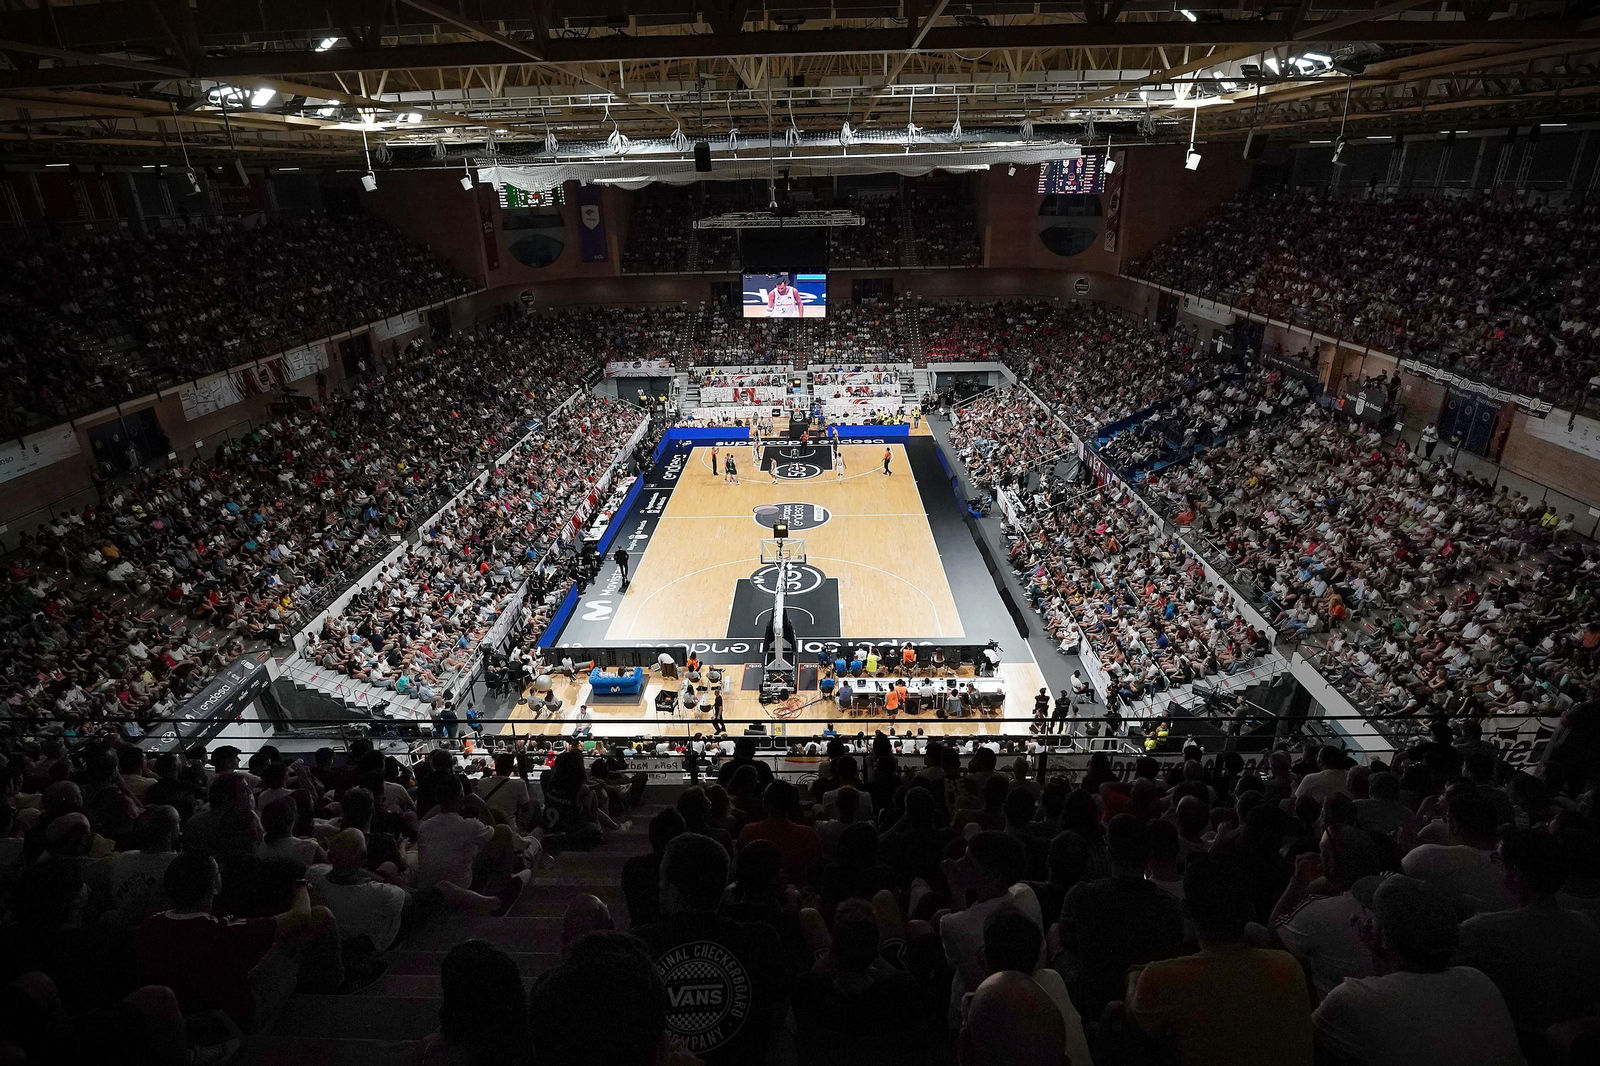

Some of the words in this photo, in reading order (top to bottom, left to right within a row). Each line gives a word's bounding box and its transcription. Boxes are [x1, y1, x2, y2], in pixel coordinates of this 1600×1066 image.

[200, 684, 231, 711] endesa
[546, 807, 560, 829] 9
[658, 947, 690, 976] GINAL
[693, 944, 748, 1019] CHECKERBOARD
[667, 984, 724, 1007] VANS
